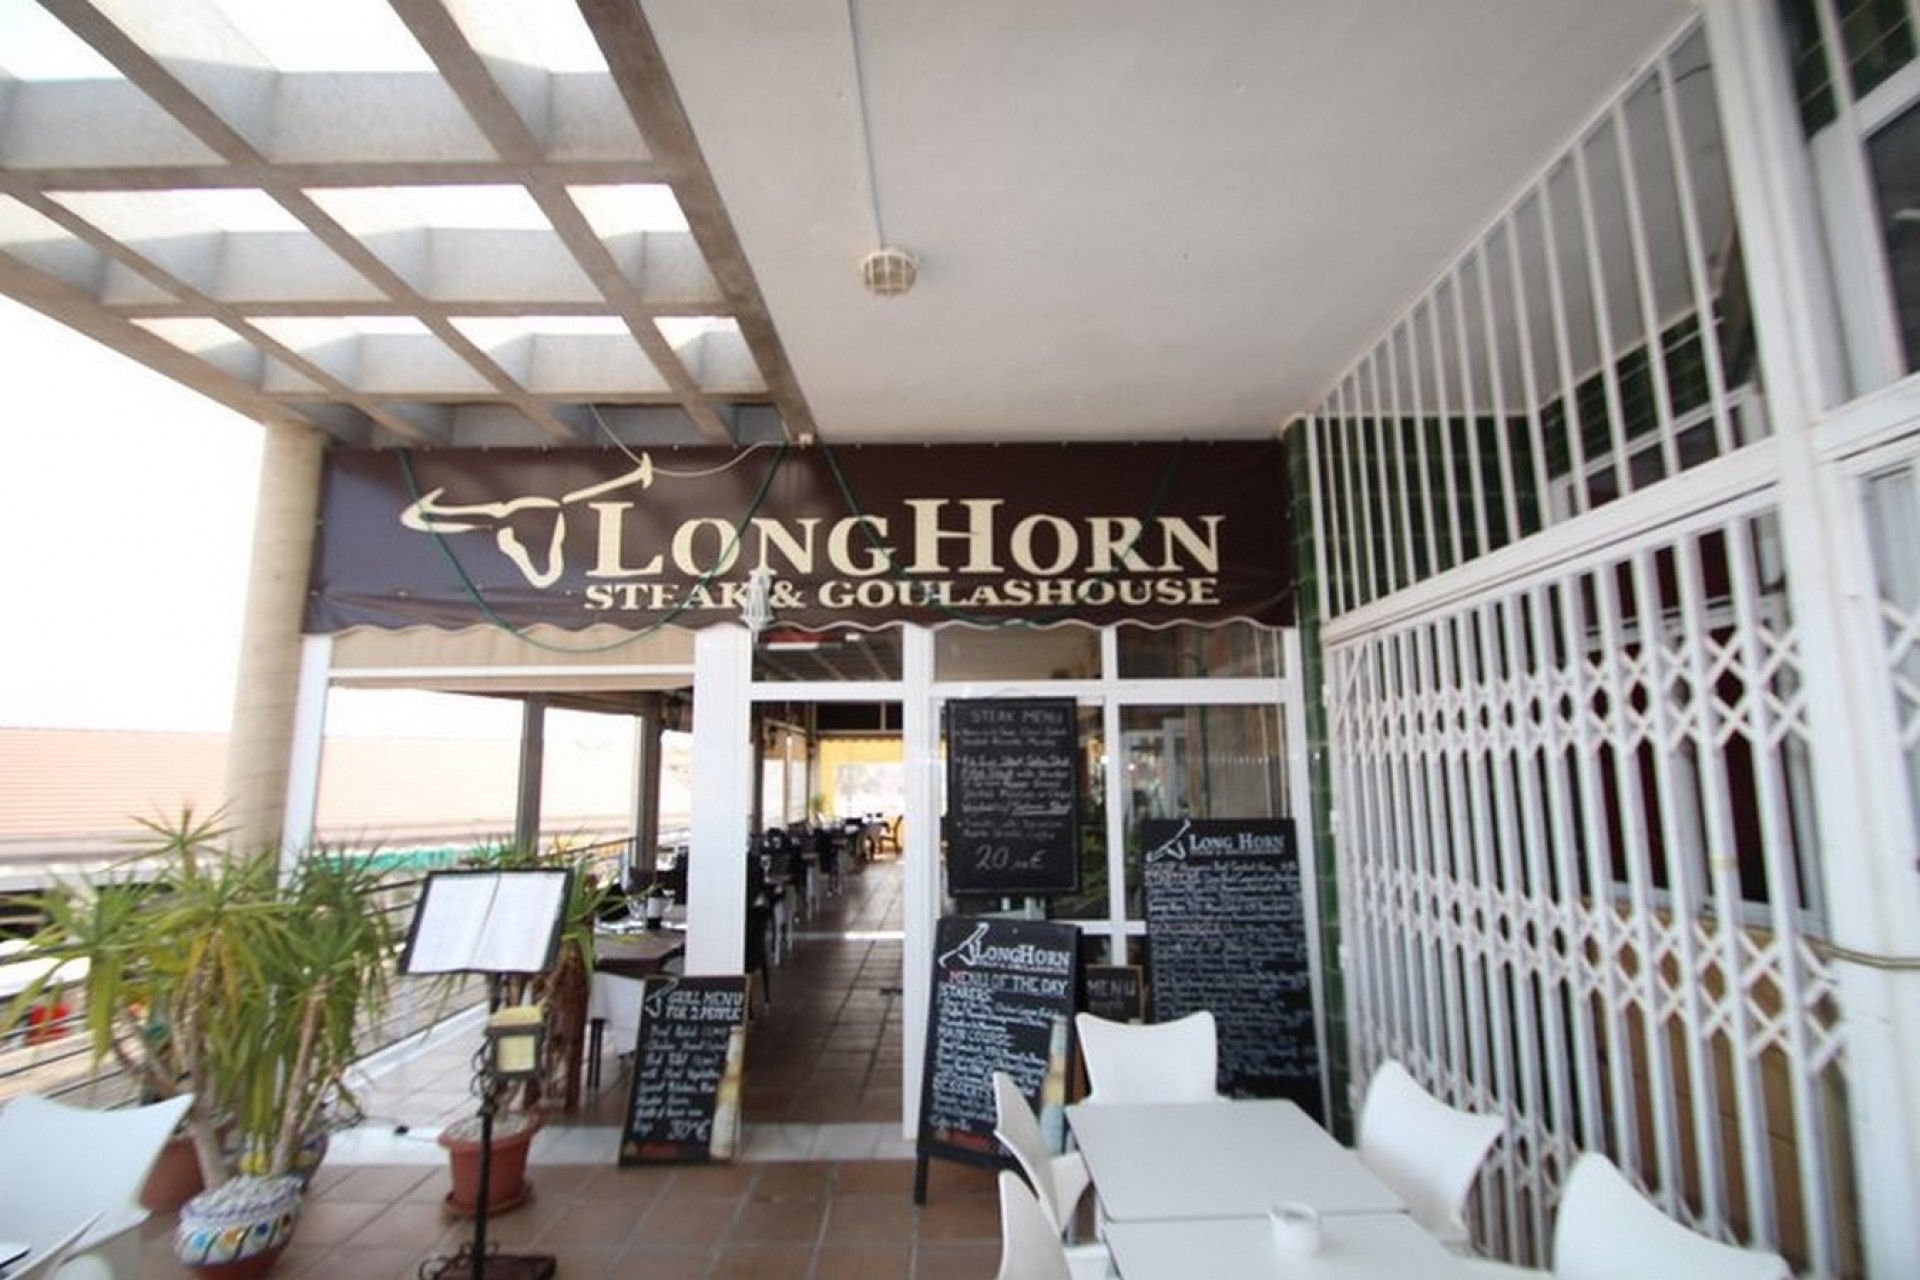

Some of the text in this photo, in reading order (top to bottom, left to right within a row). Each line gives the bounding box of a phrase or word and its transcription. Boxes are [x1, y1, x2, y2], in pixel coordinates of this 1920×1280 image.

[769, 580, 807, 609] &
[817, 577, 1222, 606] GOULASHOUSE
[969, 709, 1064, 723] STEAK MENU
[1188, 833, 1233, 850] LONG
[975, 939, 1072, 966] LONGHORN
[948, 970, 988, 986] MENU
[1011, 974, 1041, 993] THE
